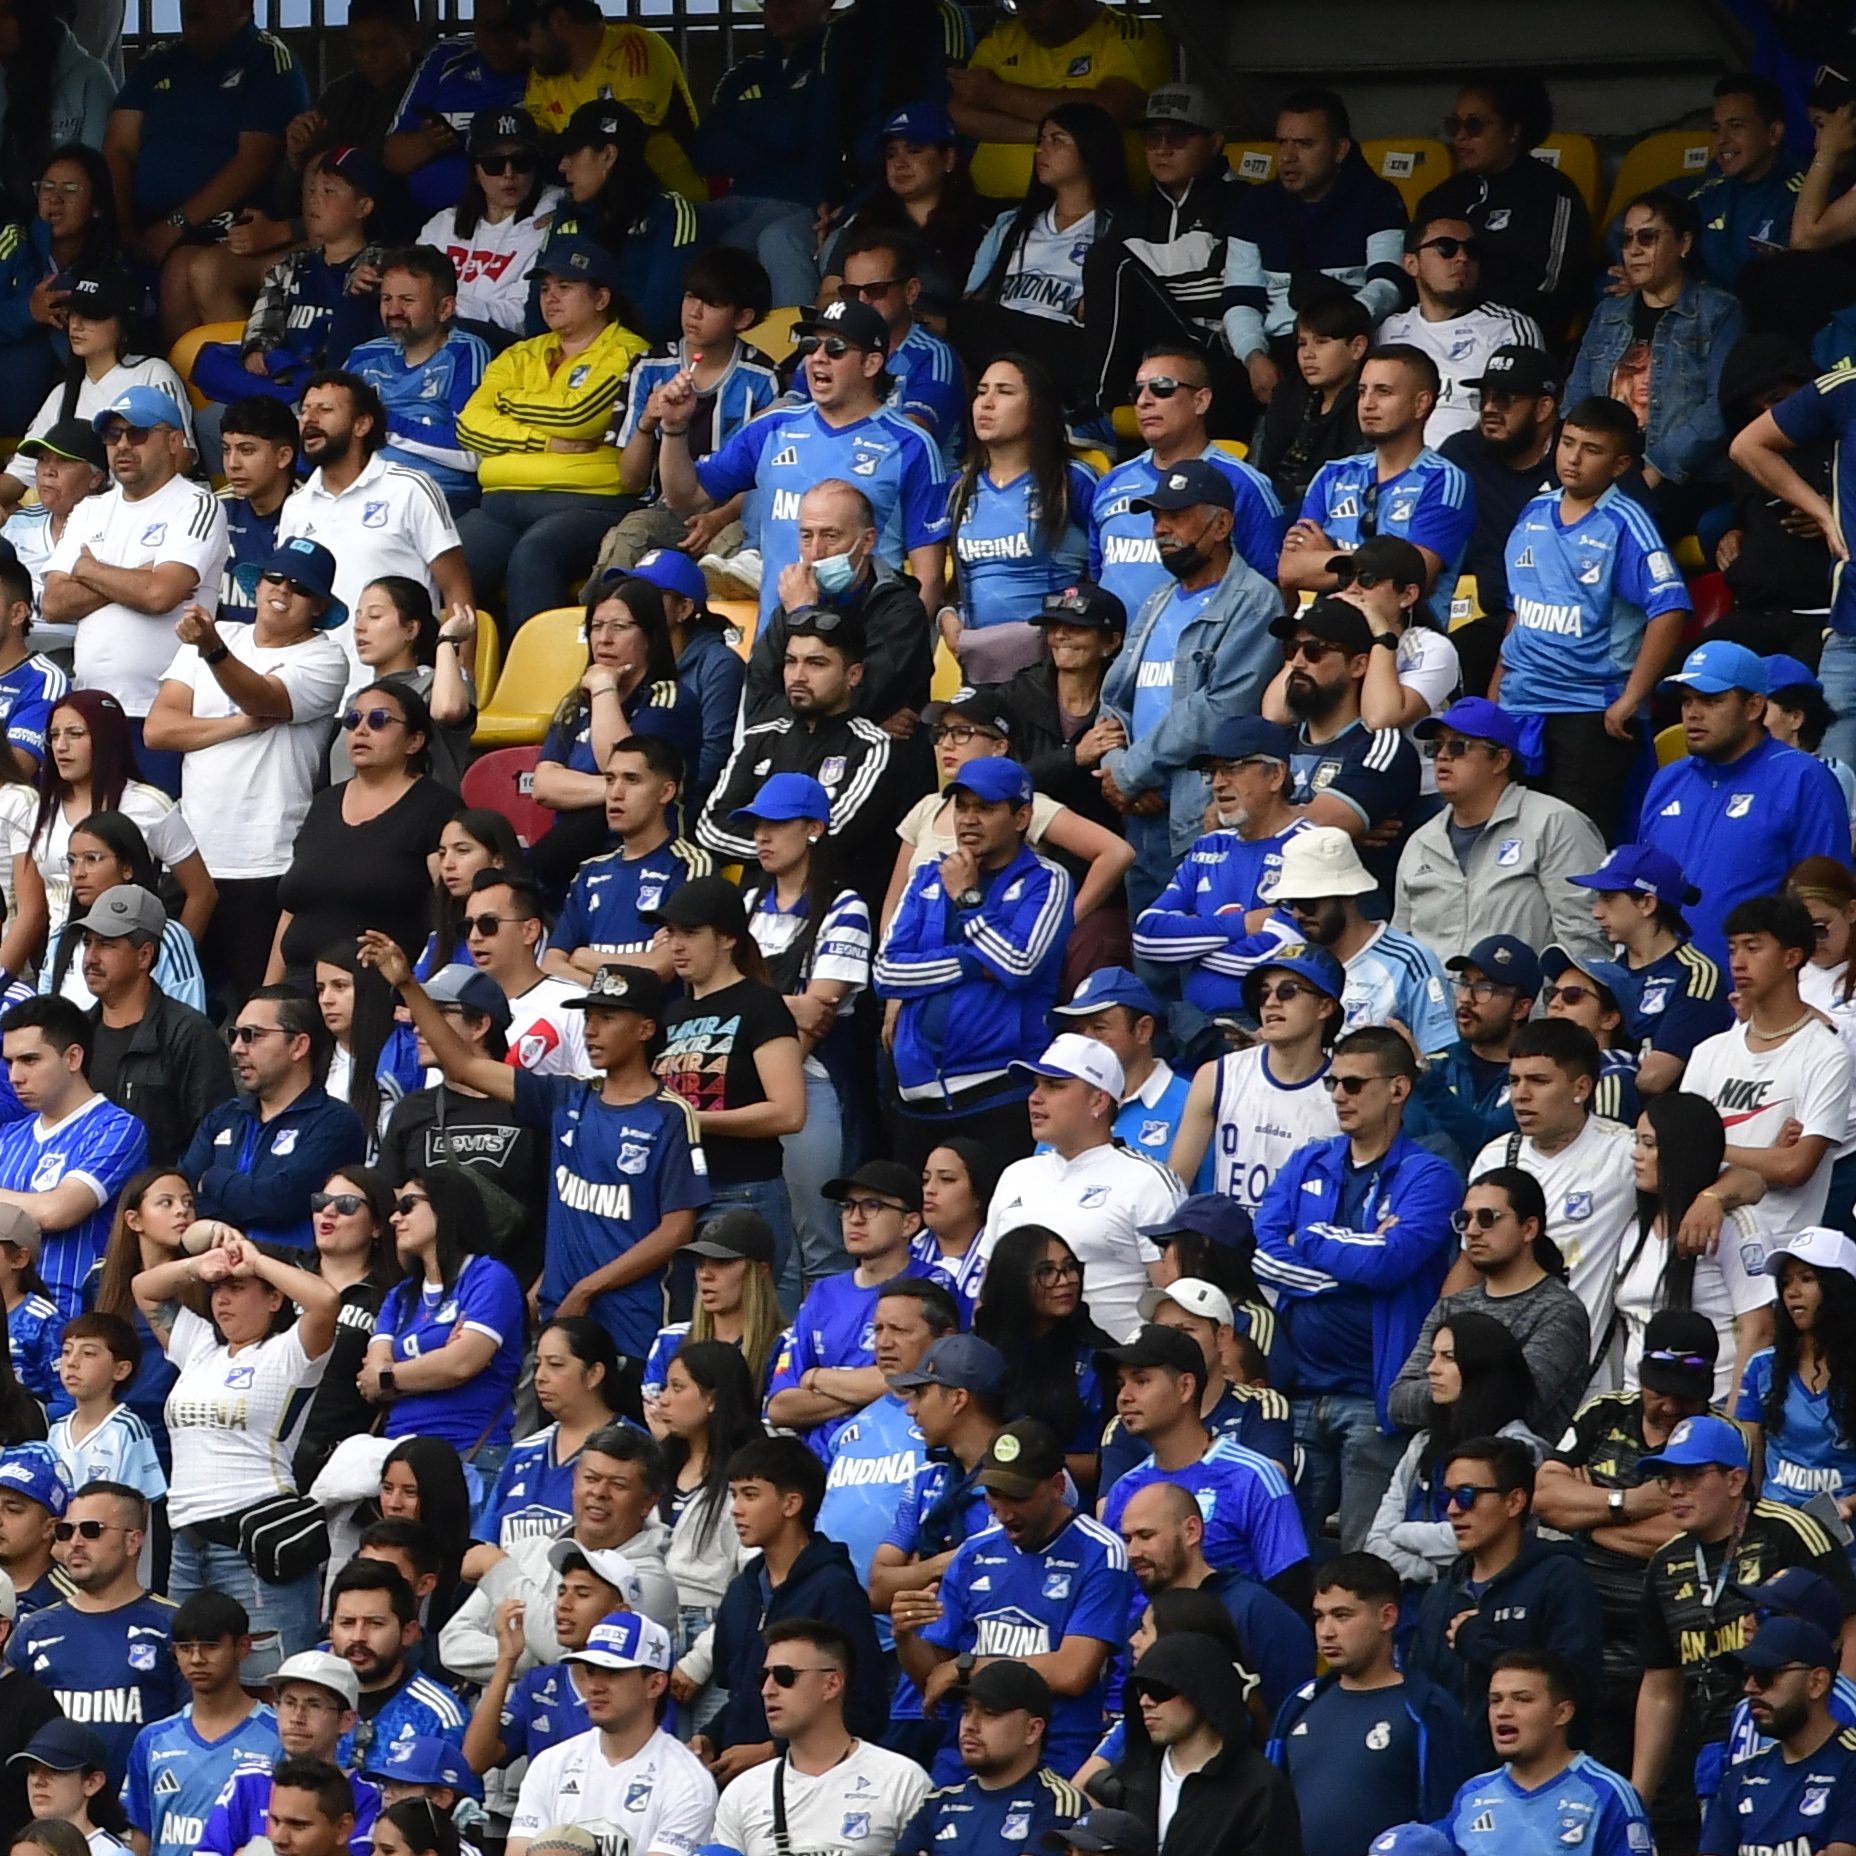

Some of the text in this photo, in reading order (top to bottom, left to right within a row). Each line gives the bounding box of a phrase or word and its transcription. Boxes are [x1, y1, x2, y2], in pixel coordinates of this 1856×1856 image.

[497, 113, 516, 135] NY
[75, 280, 100, 294] NYC
[1001, 269, 1073, 306] ANDINA
[823, 300, 845, 320] NY
[957, 533, 1032, 562] ANDINA
[1106, 535, 1162, 564] ANDIN
[828, 942, 870, 960] LEONA
[1719, 1074, 1772, 1110] NIKE
[1254, 1123, 1292, 1139] adidas
[554, 1165, 632, 1222] ANDINA
[827, 1451, 916, 1490] ANDINA
[1776, 1459, 1844, 1493] ANDINA
